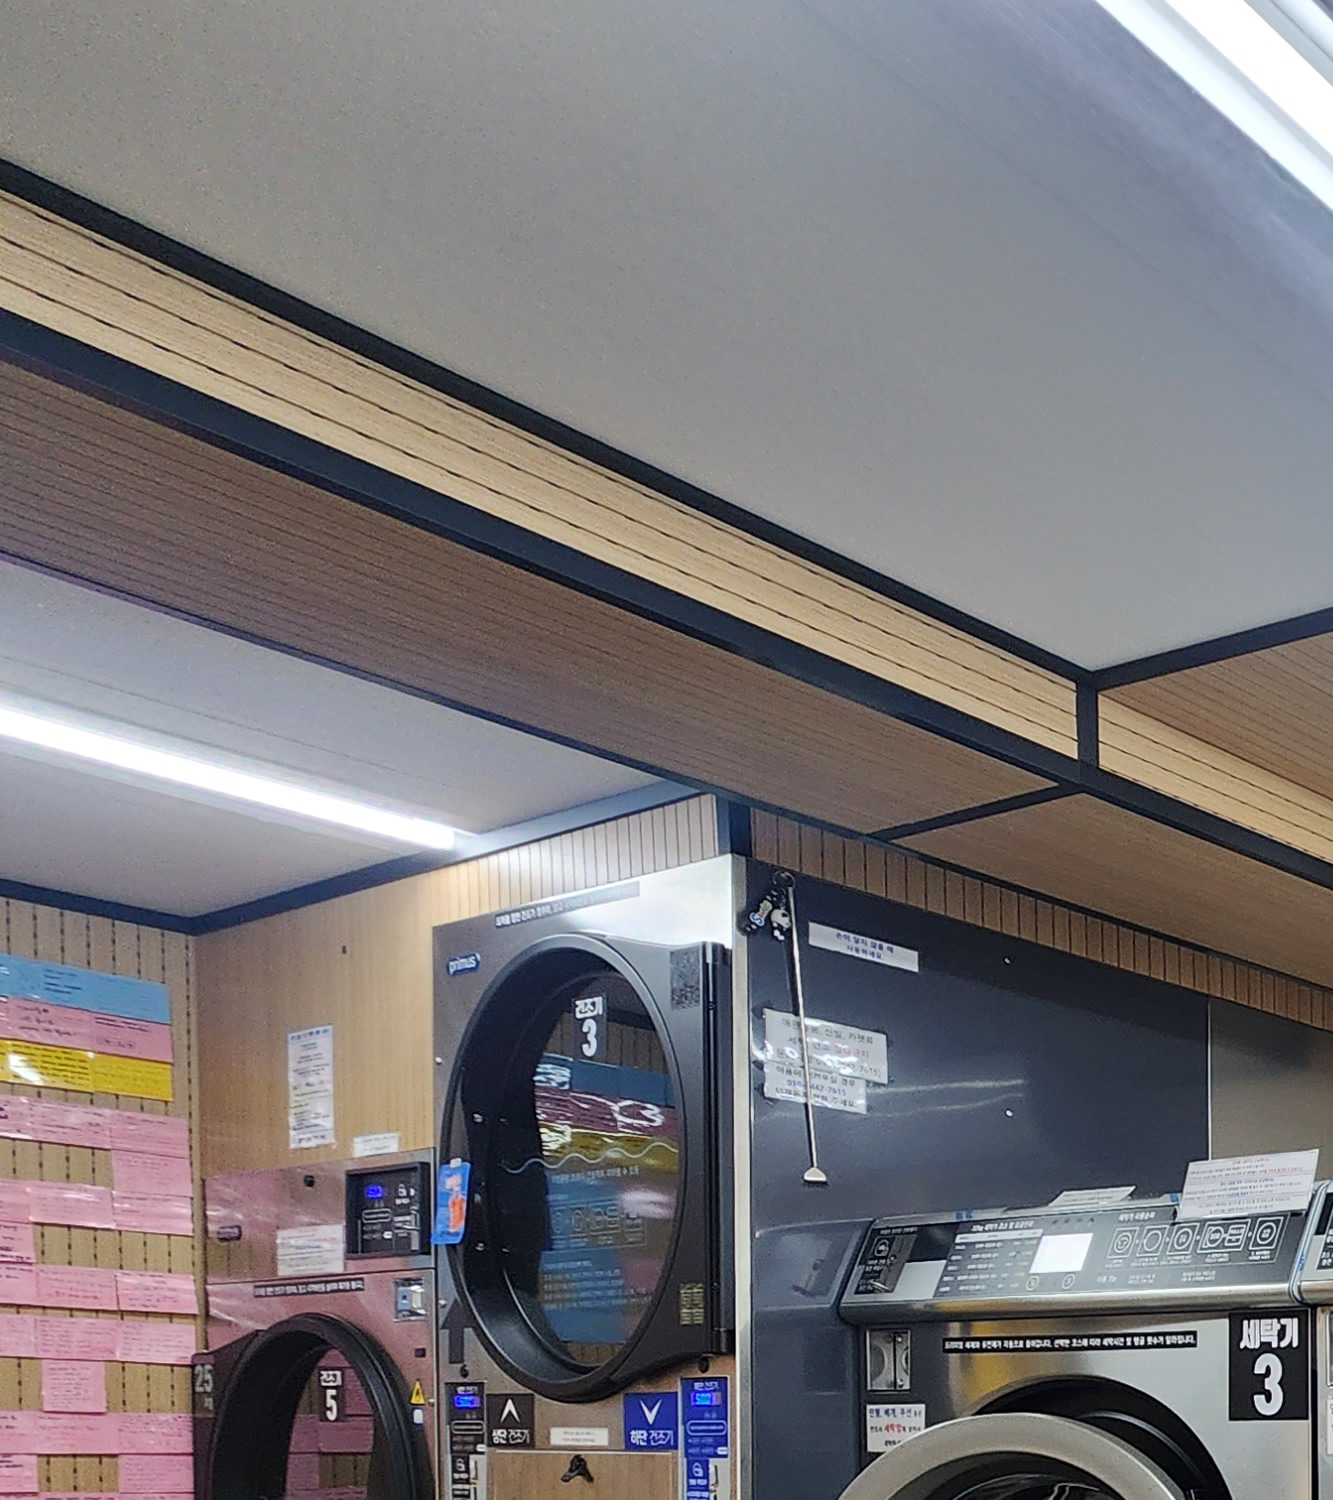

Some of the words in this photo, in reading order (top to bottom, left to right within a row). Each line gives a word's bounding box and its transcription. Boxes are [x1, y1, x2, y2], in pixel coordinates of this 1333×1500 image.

[449, 955, 478, 976] primus
[582, 1019, 597, 1057] 3
[1239, 1318, 1299, 1350] 세탁기
[1253, 1353, 1284, 1417] 3
[326, 1389, 337, 1421] 5
